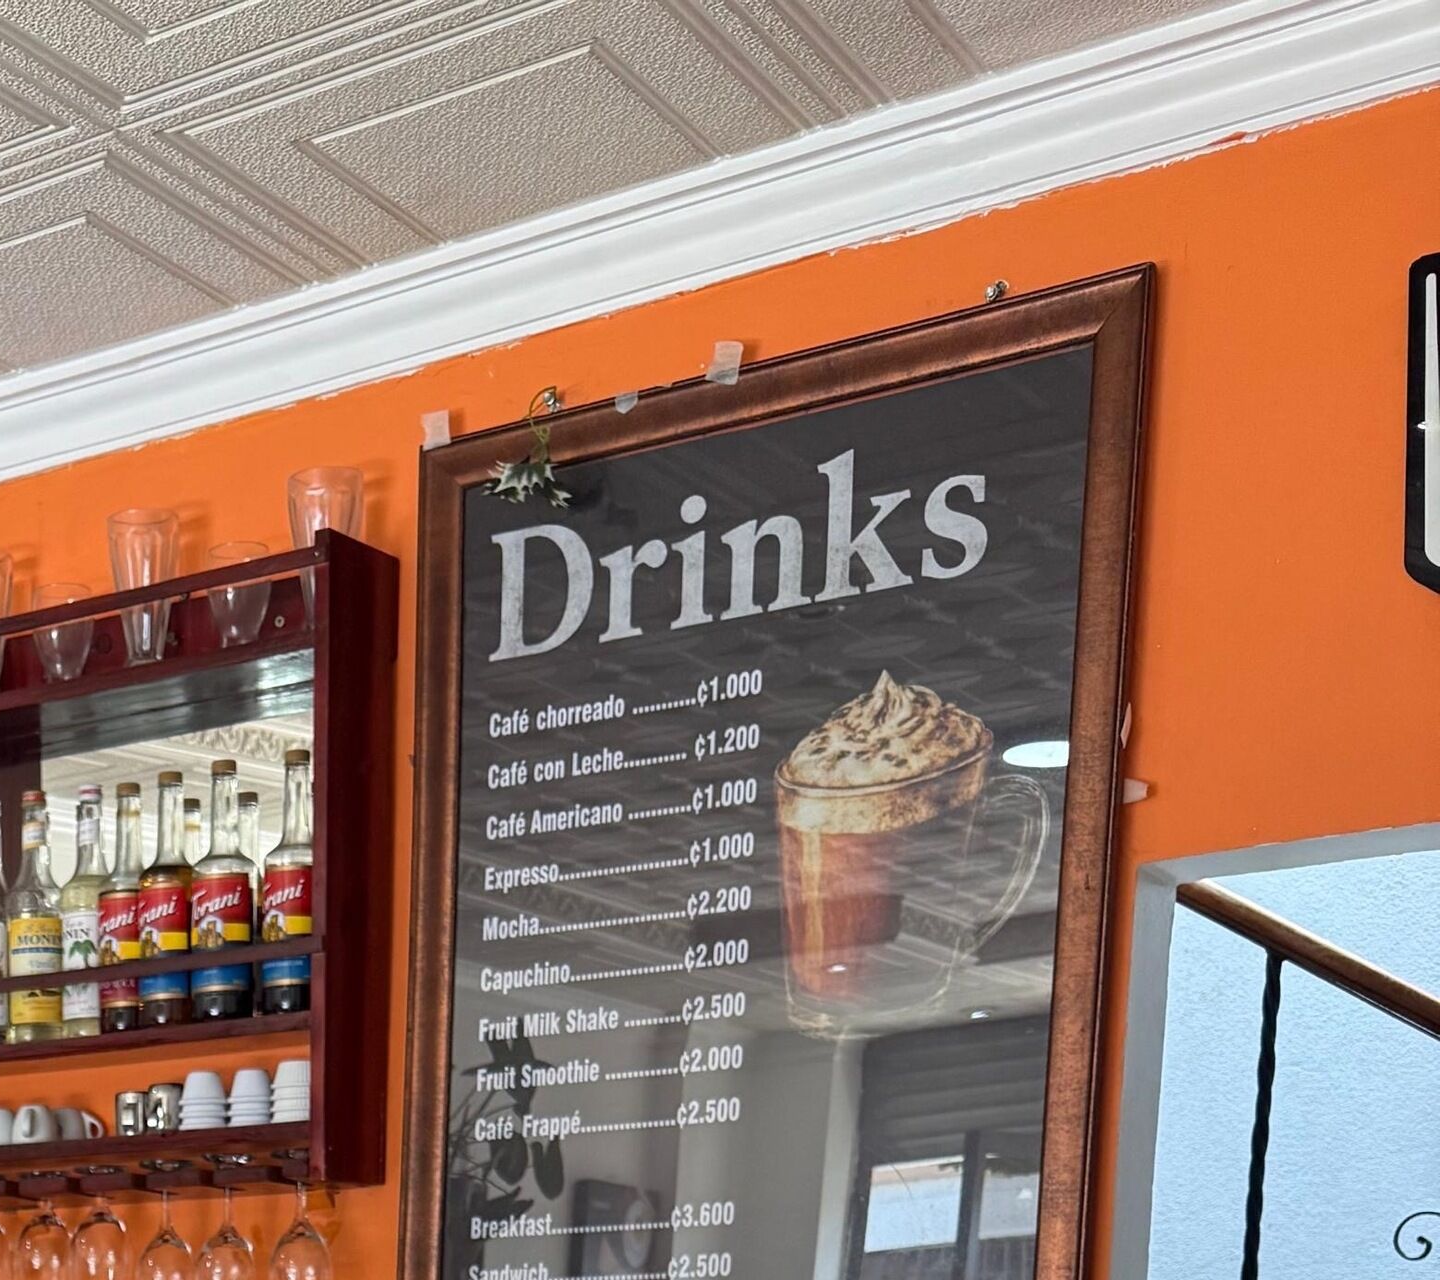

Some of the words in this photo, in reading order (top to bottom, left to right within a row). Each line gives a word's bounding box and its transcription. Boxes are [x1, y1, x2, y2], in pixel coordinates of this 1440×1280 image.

[489, 449, 989, 663] Drinks
[489, 708, 529, 738] Café
[536, 694, 625, 731] chorreado
[488, 759, 527, 789] Café
[534, 759, 565, 782] con
[486, 811, 525, 840] Café
[529, 802, 623, 834] Americano
[478, 1016, 518, 1042] Fruit
[523, 1011, 560, 1038] Milk
[565, 1006, 619, 1034] Shake
[476, 1066, 516, 1092] Fruit
[520, 1059, 600, 1088] Smoothie
[474, 1117, 513, 1142] Café
